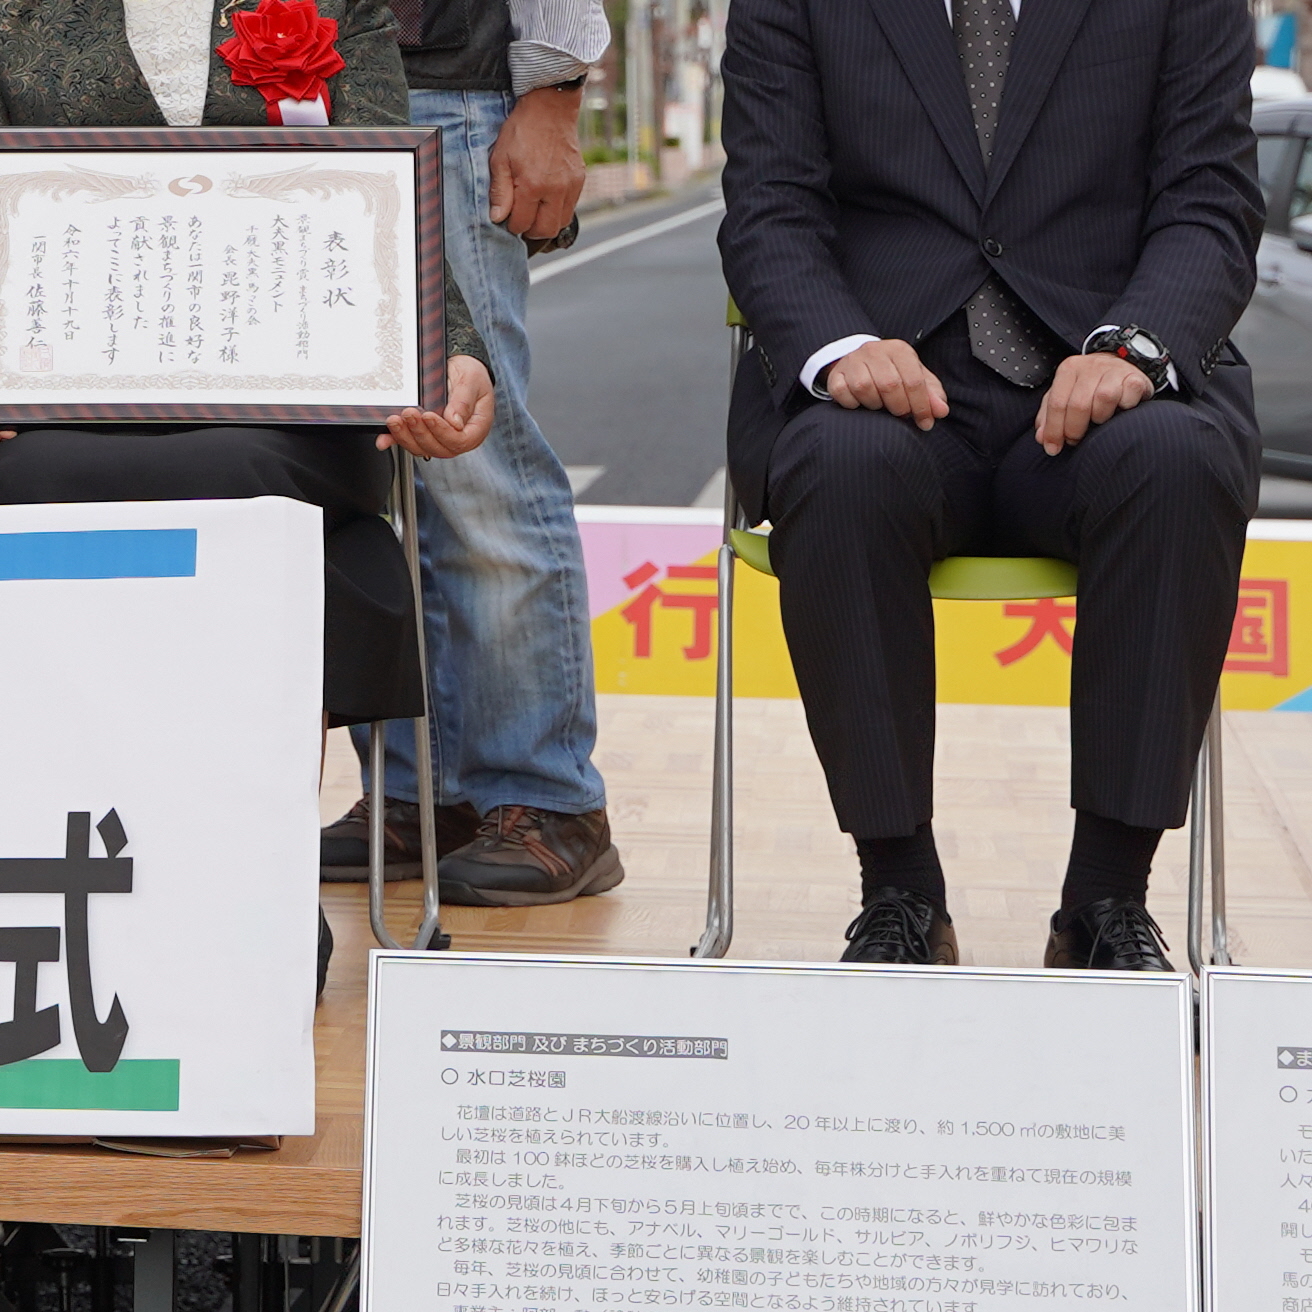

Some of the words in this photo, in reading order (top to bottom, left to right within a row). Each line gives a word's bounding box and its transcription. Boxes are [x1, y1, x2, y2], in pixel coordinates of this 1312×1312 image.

[61, 223, 81, 340] 令和六年十月十九日
[101, 216, 123, 365] よってここに表彰します
[129, 215, 152, 329] 貢献されました
[158, 215, 179, 363] 景観まちづくりの推進に
[268, 214, 288, 312] 大夫黒モニュメント
[321, 230, 355, 308] 表彰状
[457, 1033, 526, 1052] 景観部門
[531, 1035, 567, 1053] 及び
[573, 1036, 729, 1057] まちづくり活動部門
[467, 1068, 566, 1089] 水口芝桜園
[438, 1172, 566, 1190] に成長しました。
